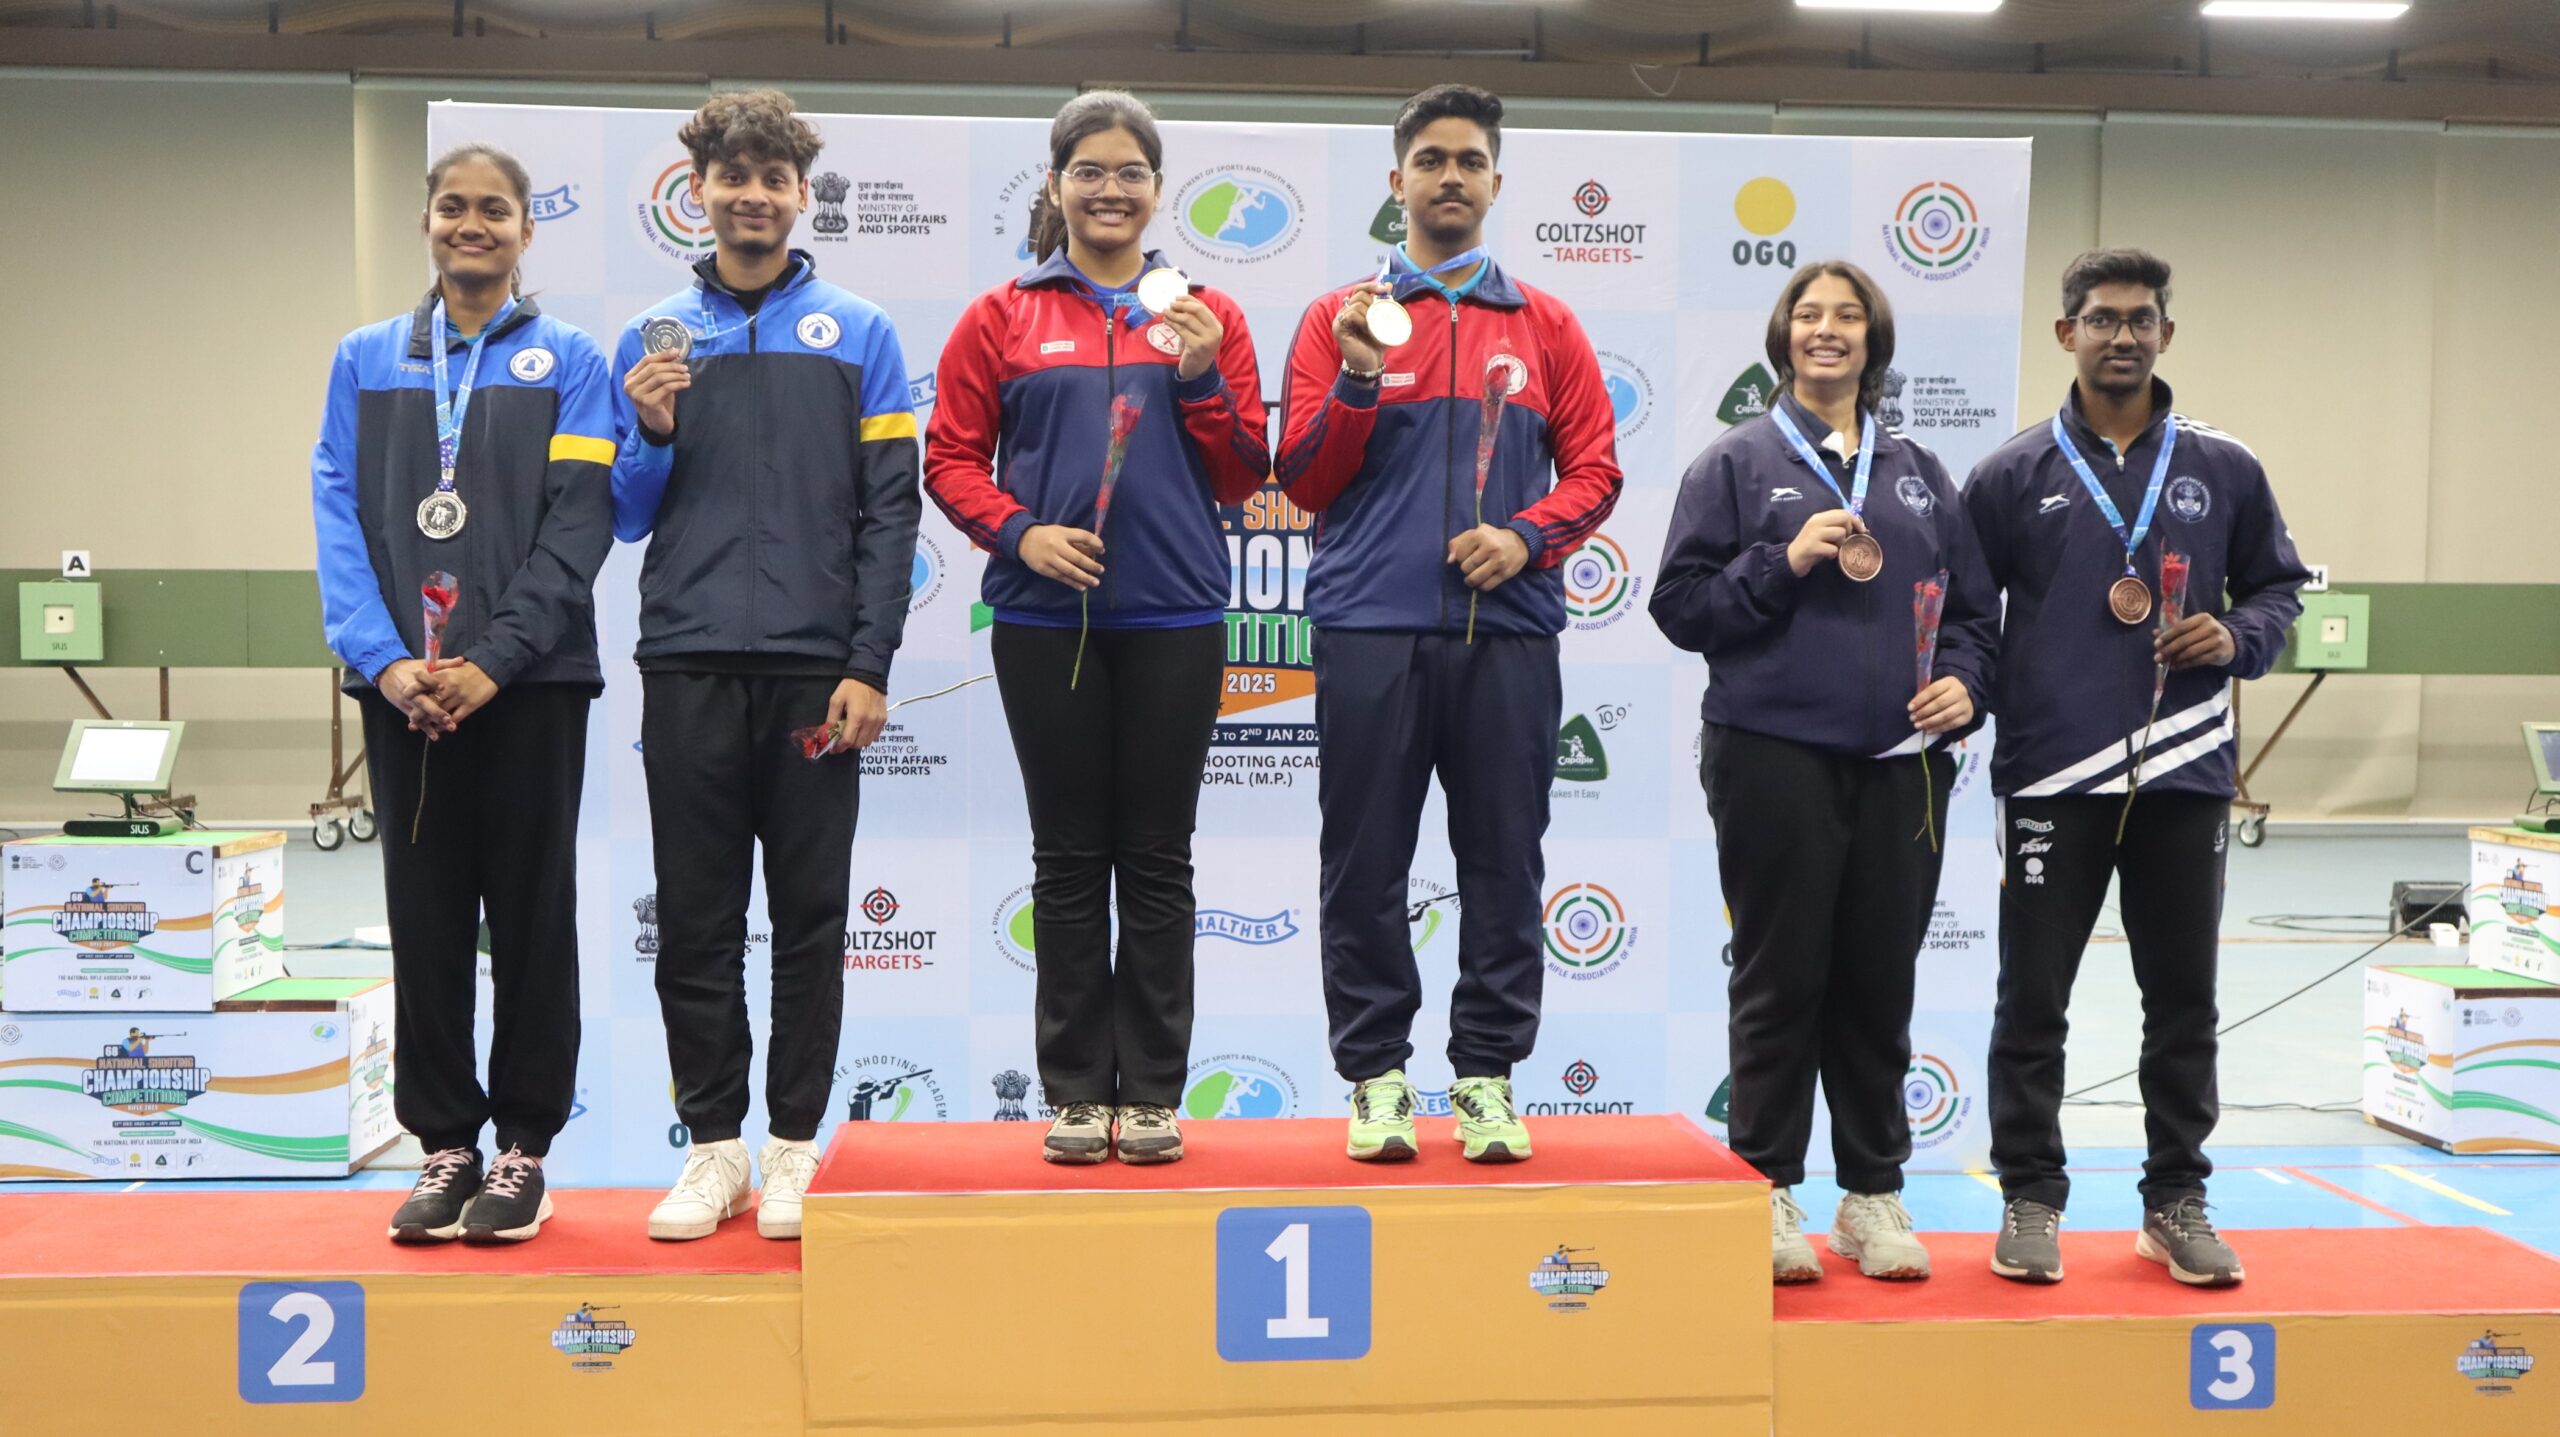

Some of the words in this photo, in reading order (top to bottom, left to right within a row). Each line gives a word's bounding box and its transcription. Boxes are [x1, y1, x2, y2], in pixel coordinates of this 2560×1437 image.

[1000, 170, 1030, 203] STATE
[1172, 172, 1204, 211] DEPARTMENT
[1205, 167, 1215, 176] OF
[1216, 164, 1244, 173] SPORTS
[1246, 164, 1262, 173] AND
[1264, 169, 1286, 186] YOUTH
[1286, 183, 1305, 213] WELFARE
[858, 203, 903, 213] MINISTRY
[905, 203, 919, 213] OF
[857, 213, 898, 223] YOUTH
[900, 214, 948, 224] AFFAIRS
[638, 203, 658, 243] NATIONAL
[658, 241, 681, 259] RIFLE
[857, 224, 884, 234] AND
[886, 225, 931, 235] SPORTS
[1535, 222, 1647, 245] COLTZSHOT
[1175, 225, 1222, 262] GOVERNMENT
[1224, 256, 1234, 264] OF
[1237, 253, 1272, 264] MADHYA
[1732, 239, 1797, 268] OGQ
[1882, 224, 1900, 262] NATIONAL
[1900, 261, 1921, 278] RIFLE
[1924, 260, 1973, 281] ASSOCIATION
[1972, 250, 1981, 261] OF
[1979, 226, 1991, 248] INDIA
[1553, 247, 1633, 264] TARGETS
[1613, 353, 1635, 370] YOUTH
[1635, 368, 1654, 396] WELFARE
[1913, 398, 1955, 407] MINISTRY
[1957, 398, 1970, 407] OF
[1913, 408, 1950, 417] YOUTH
[1953, 408, 1997, 418] AFFAIRS
[1623, 411, 1651, 440] PRADESH
[1913, 419, 1937, 428] AND
[1940, 419, 1981, 428] SPORTS
[926, 537, 945, 568] WELFARE
[67, 555, 86, 571] A
[913, 582, 943, 612] PRADESH
[1574, 610, 1625, 631] ASSOCIATION
[1624, 599, 1633, 611] OF
[1631, 575, 1642, 598] INDIA
[1226, 672, 1277, 694] 2025
[1222, 731, 1237, 741] TO
[1239, 727, 1263, 741] 2ND
[1265, 728, 1293, 741] JAN
[860, 745, 904, 754] MINISTRY
[906, 745, 919, 754] OF
[860, 755, 898, 765] YOUTH
[901, 755, 948, 765] AFFAIRS
[1968, 752, 1980, 774] INDIA
[859, 766, 884, 776] AND
[887, 766, 931, 776] SPORTS
[1249, 772, 1293, 788] (M.P.)
[1581, 789, 1601, 800] Easy
[130, 824, 150, 835] SIUS
[2017, 840, 2053, 855] JSW
[185, 851, 204, 874] C
[2025, 875, 2045, 885] OGQ
[992, 887, 1023, 926] DEPARTMENT
[52, 912, 159, 933] CHAMPIONSHIP
[1943, 931, 1986, 939] AFFAIRS
[1547, 961, 1569, 978] RIFLE
[1571, 959, 1621, 981] ASSOCIATION
[1620, 949, 1629, 960] OF
[1627, 926, 1638, 947] INDIA
[1929, 941, 1970, 950] SPORTS
[844, 954, 922, 970] TARGETS
[98, 1058, 144, 1068] NATIONAL
[148, 1057, 194, 1068] SHOOTING
[82, 1068, 211, 1095] CHAMPIONSHIP
[1201, 1057, 1210, 1066] OF
[1212, 1054, 1239, 1062] SPORTS
[1241, 1053, 1257, 1062] AND
[1258, 1057, 1280, 1073] YOUTH
[1280, 1070, 1299, 1099] WELFARE
[854, 1054, 918, 1074] SHOOTING
[921, 1074, 947, 1122] ACADEM
[101, 1089, 188, 1107] COMPETITIONS
[1264, 1223, 1329, 1339] 1
[1529, 1270, 1609, 1288] CHAMPIONSHIP
[266, 1291, 336, 1387] 2
[551, 1329, 636, 1347] CHAMPIONSHIP
[2207, 1329, 2256, 1401] 3
[2457, 1355, 2534, 1372] CHAMPIONSHIP
